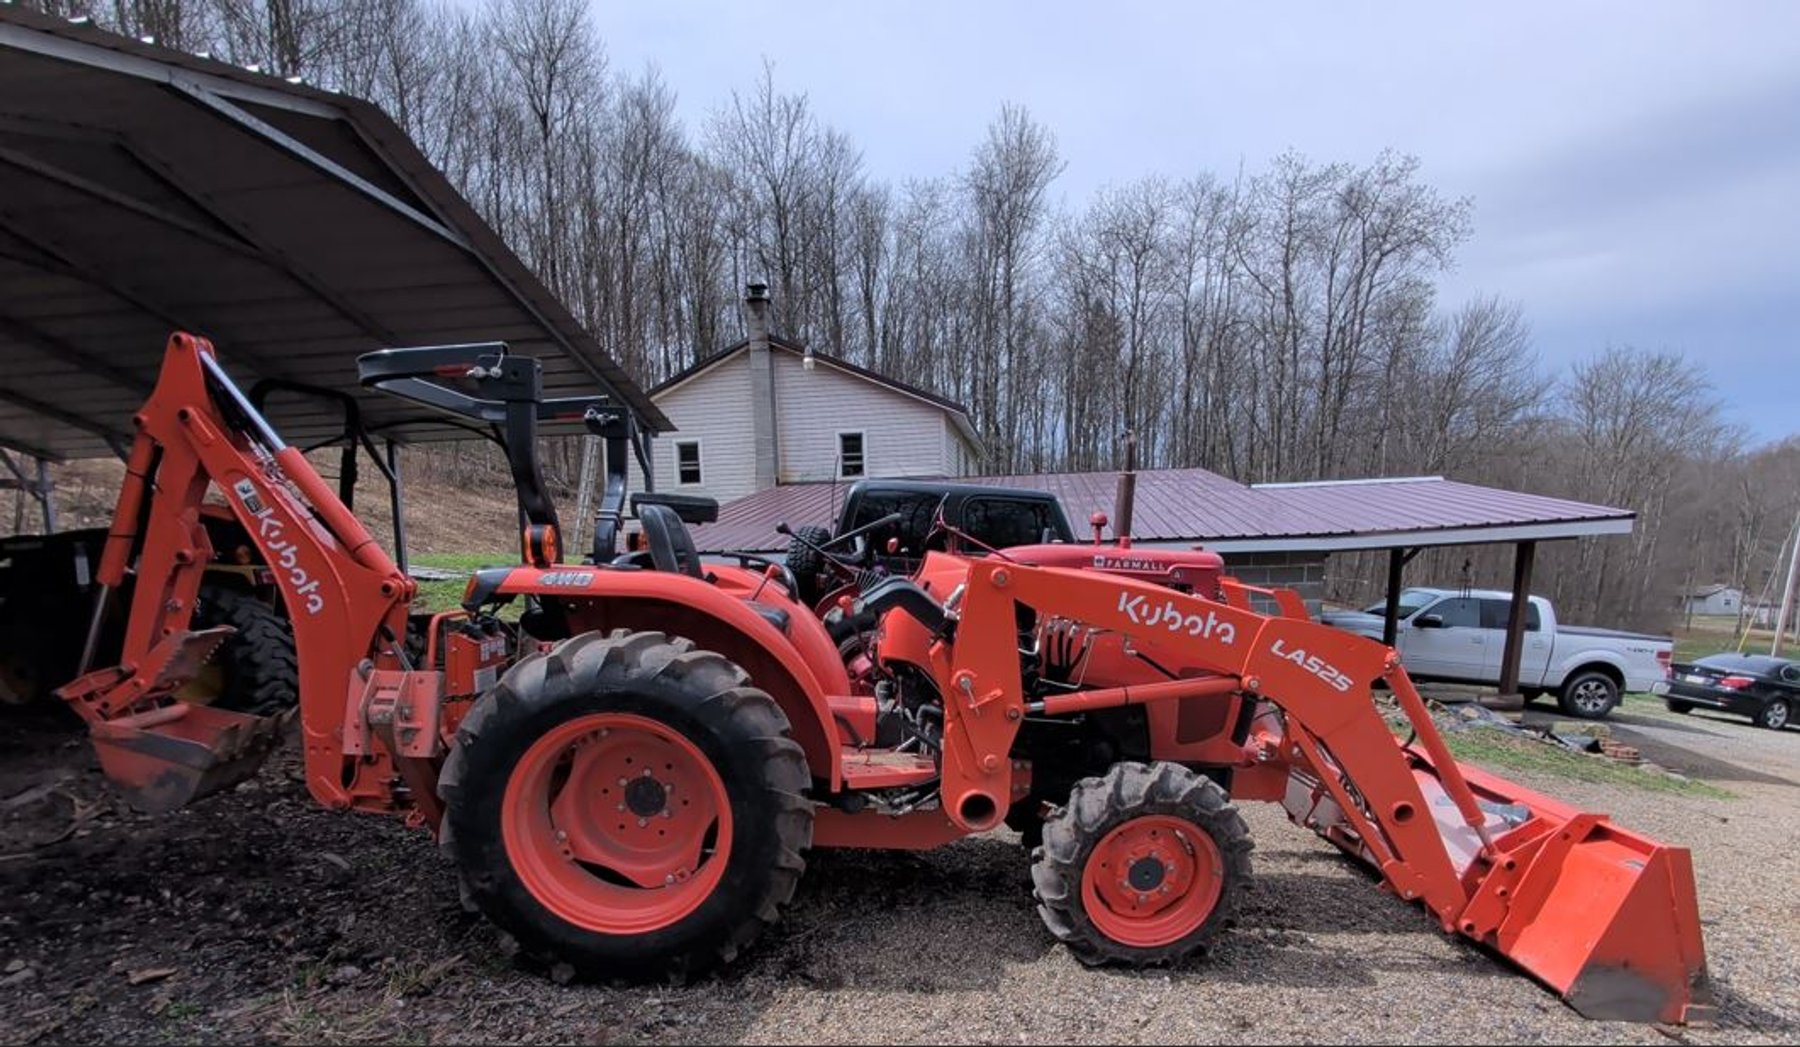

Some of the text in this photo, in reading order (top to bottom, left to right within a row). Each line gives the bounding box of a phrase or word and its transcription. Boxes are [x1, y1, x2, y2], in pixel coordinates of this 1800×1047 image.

[257, 507, 324, 615] Kubota
[1106, 559, 1166, 571] FARMALL
[1117, 591, 1236, 644] Kubota
[1270, 639, 1354, 693] LA525
